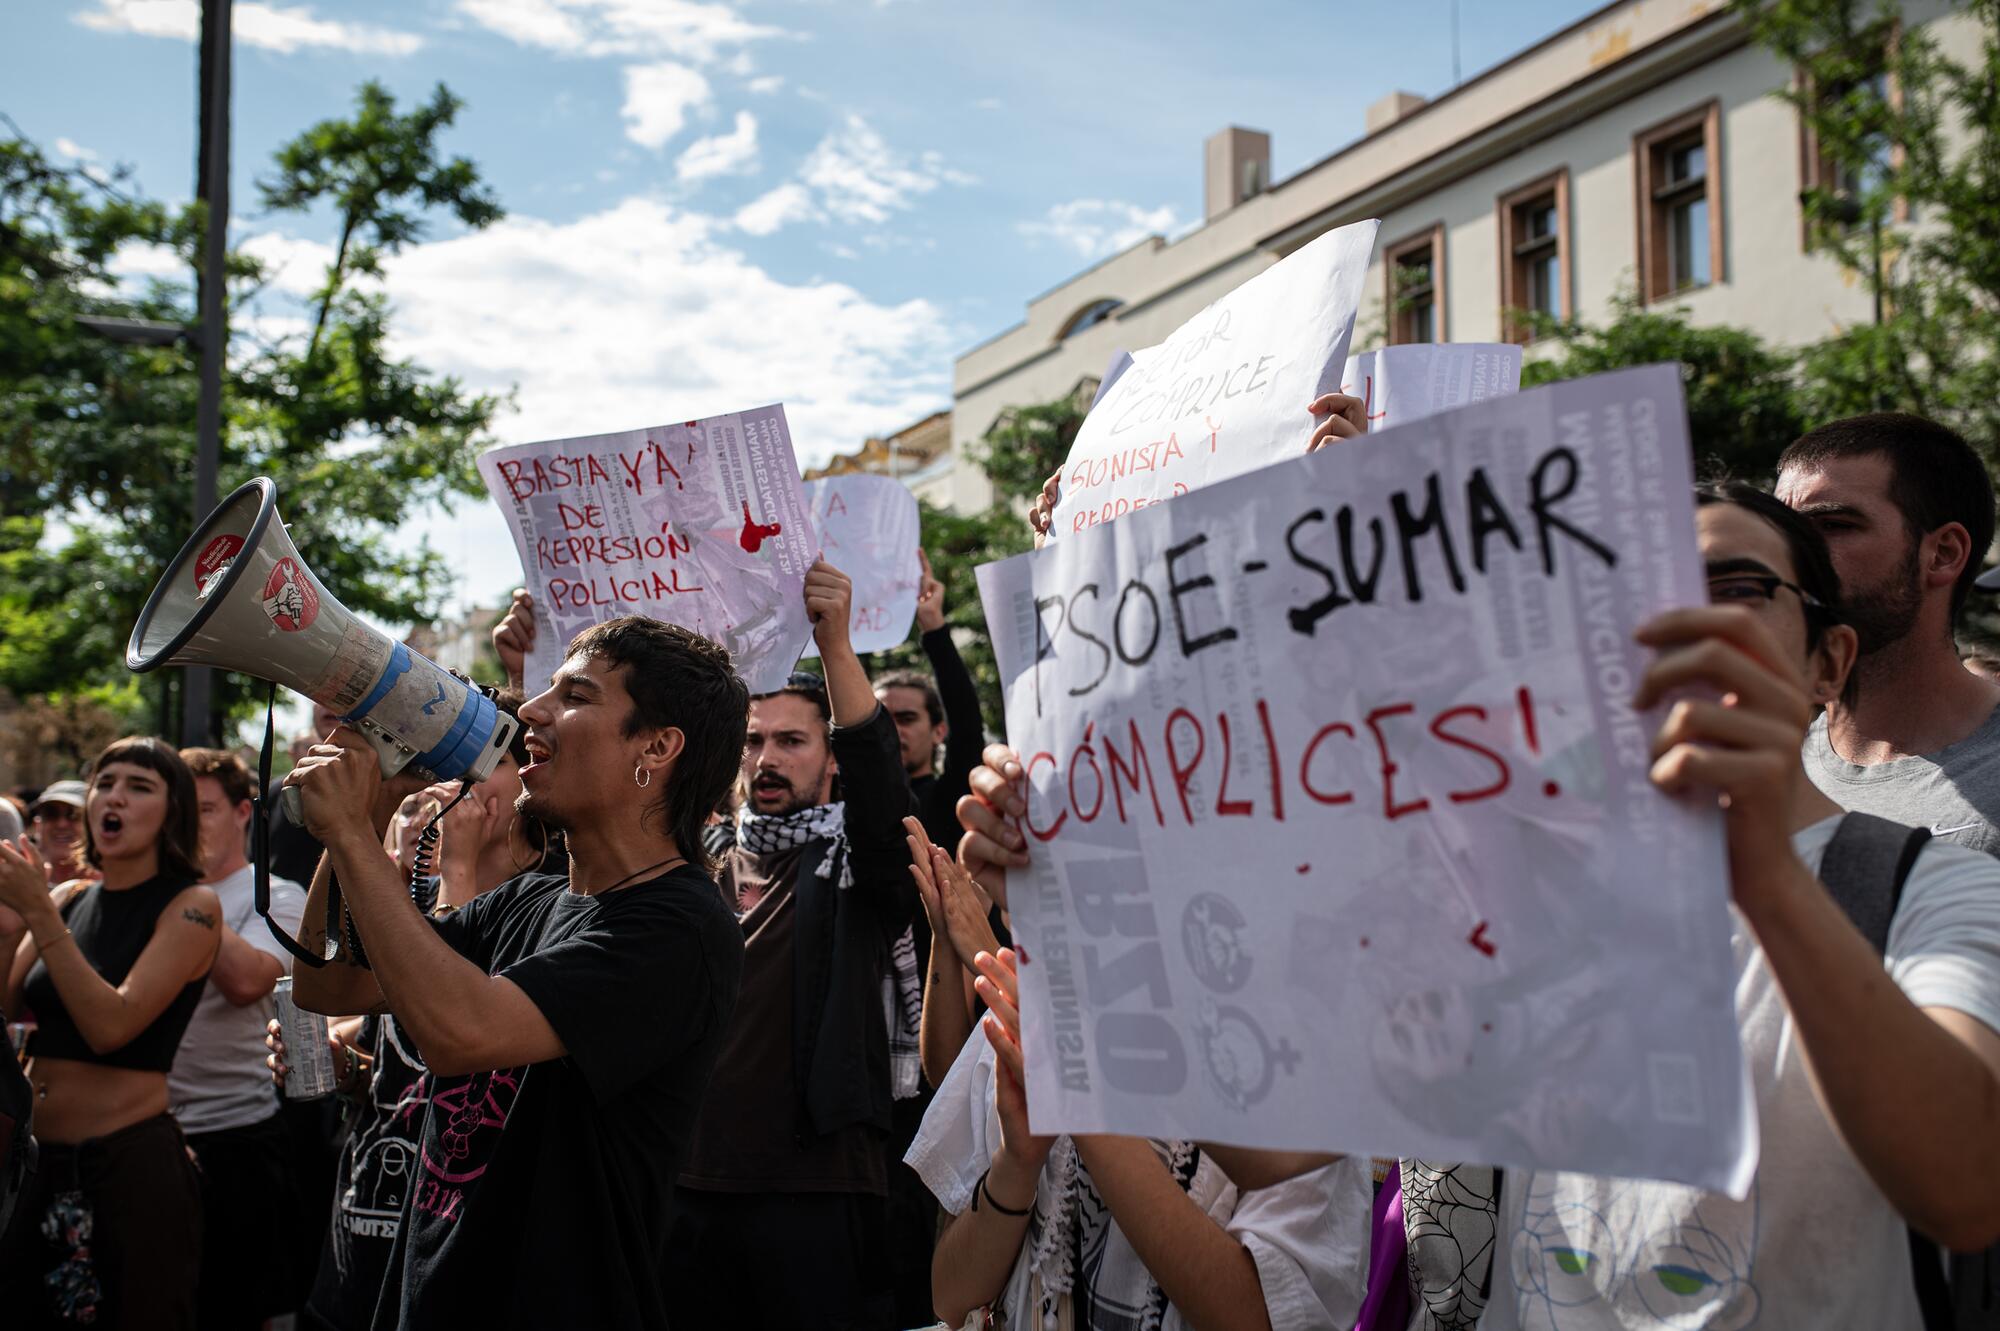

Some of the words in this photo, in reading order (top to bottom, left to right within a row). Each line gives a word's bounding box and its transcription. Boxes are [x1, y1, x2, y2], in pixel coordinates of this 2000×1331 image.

[496, 453, 609, 503] BASTA
[1069, 432, 1184, 495] SIONISTA
[557, 503, 605, 531] DE
[537, 521, 690, 570] REPRESIÓN
[549, 568, 704, 611] POLICIAL
[1034, 445, 1620, 718] PSOE-SUMAR
